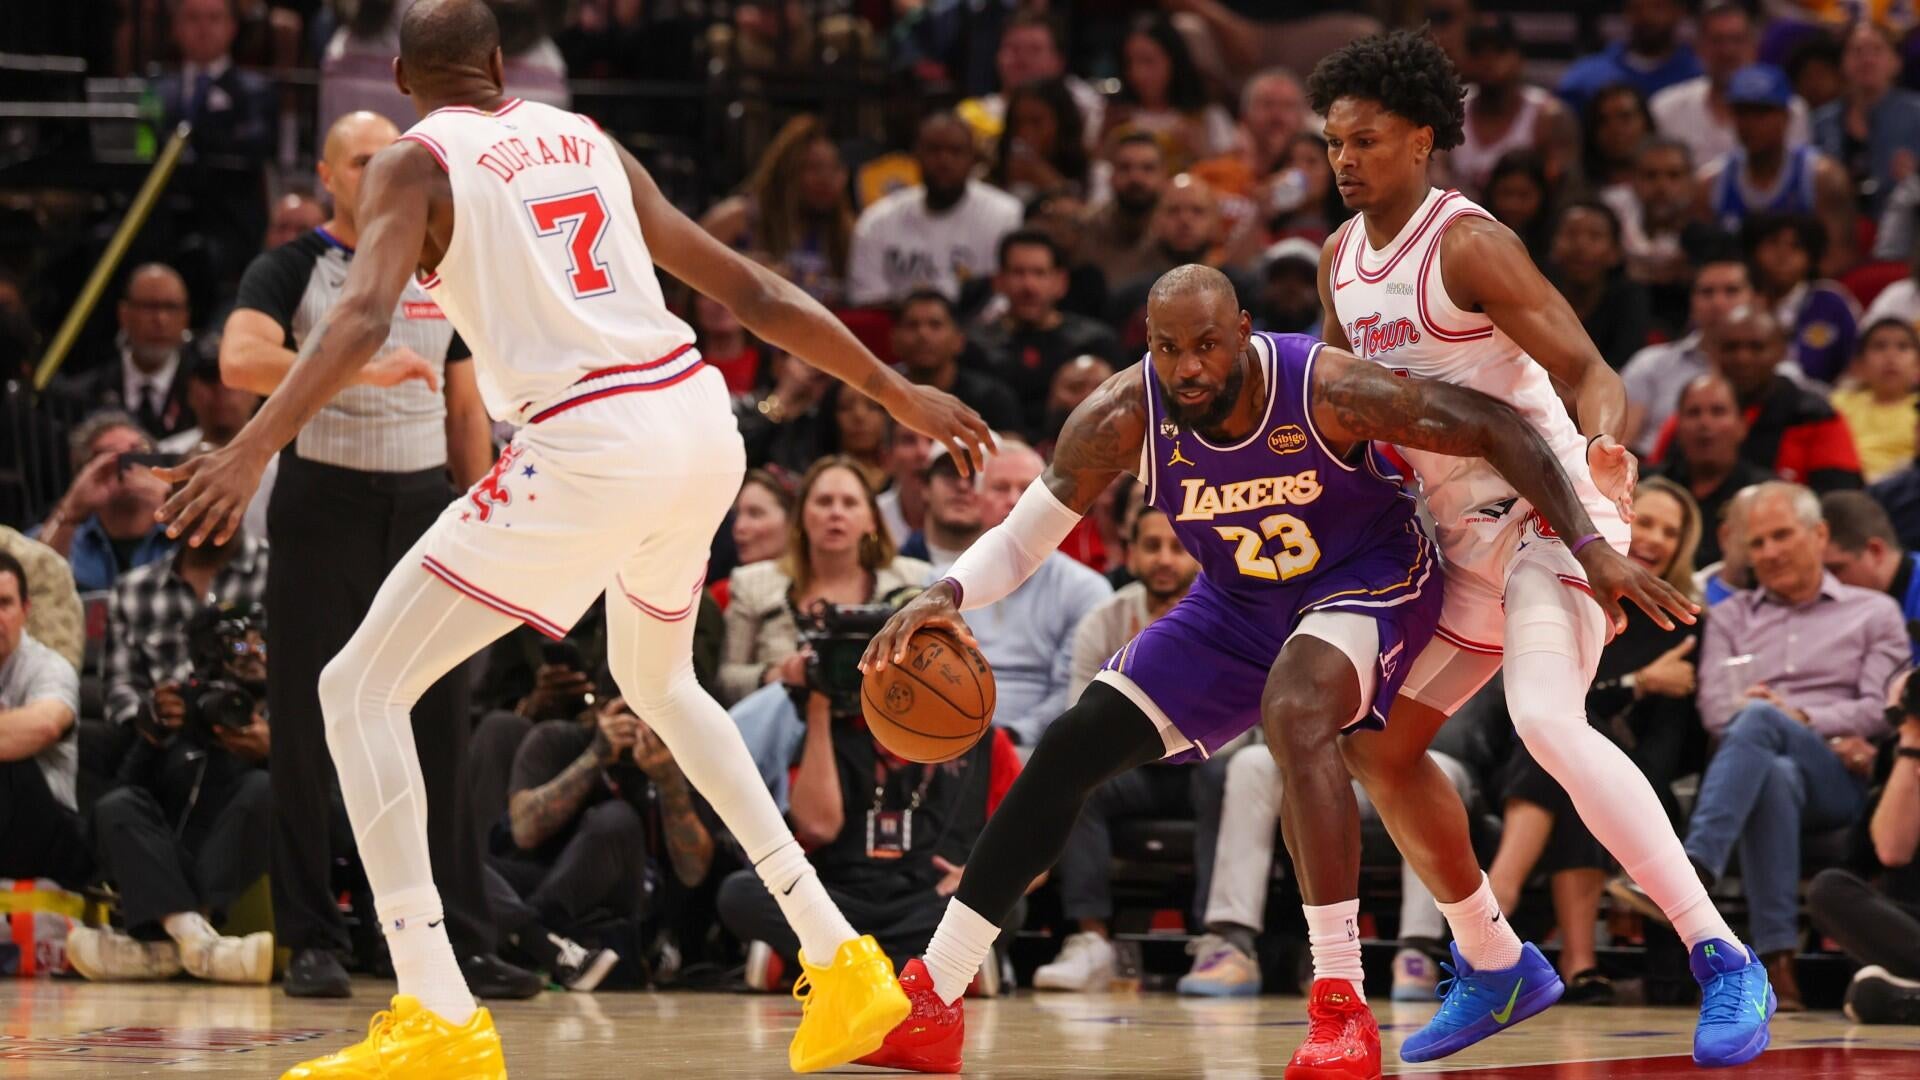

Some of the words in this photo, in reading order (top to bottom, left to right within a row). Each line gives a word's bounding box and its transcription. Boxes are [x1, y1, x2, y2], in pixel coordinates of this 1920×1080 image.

[477, 134, 596, 184] DURANT
[523, 186, 617, 300] 7
[1271, 431, 1305, 446] bibigo
[1175, 469, 1323, 522] LAKERS
[1211, 513, 1321, 582] 23
